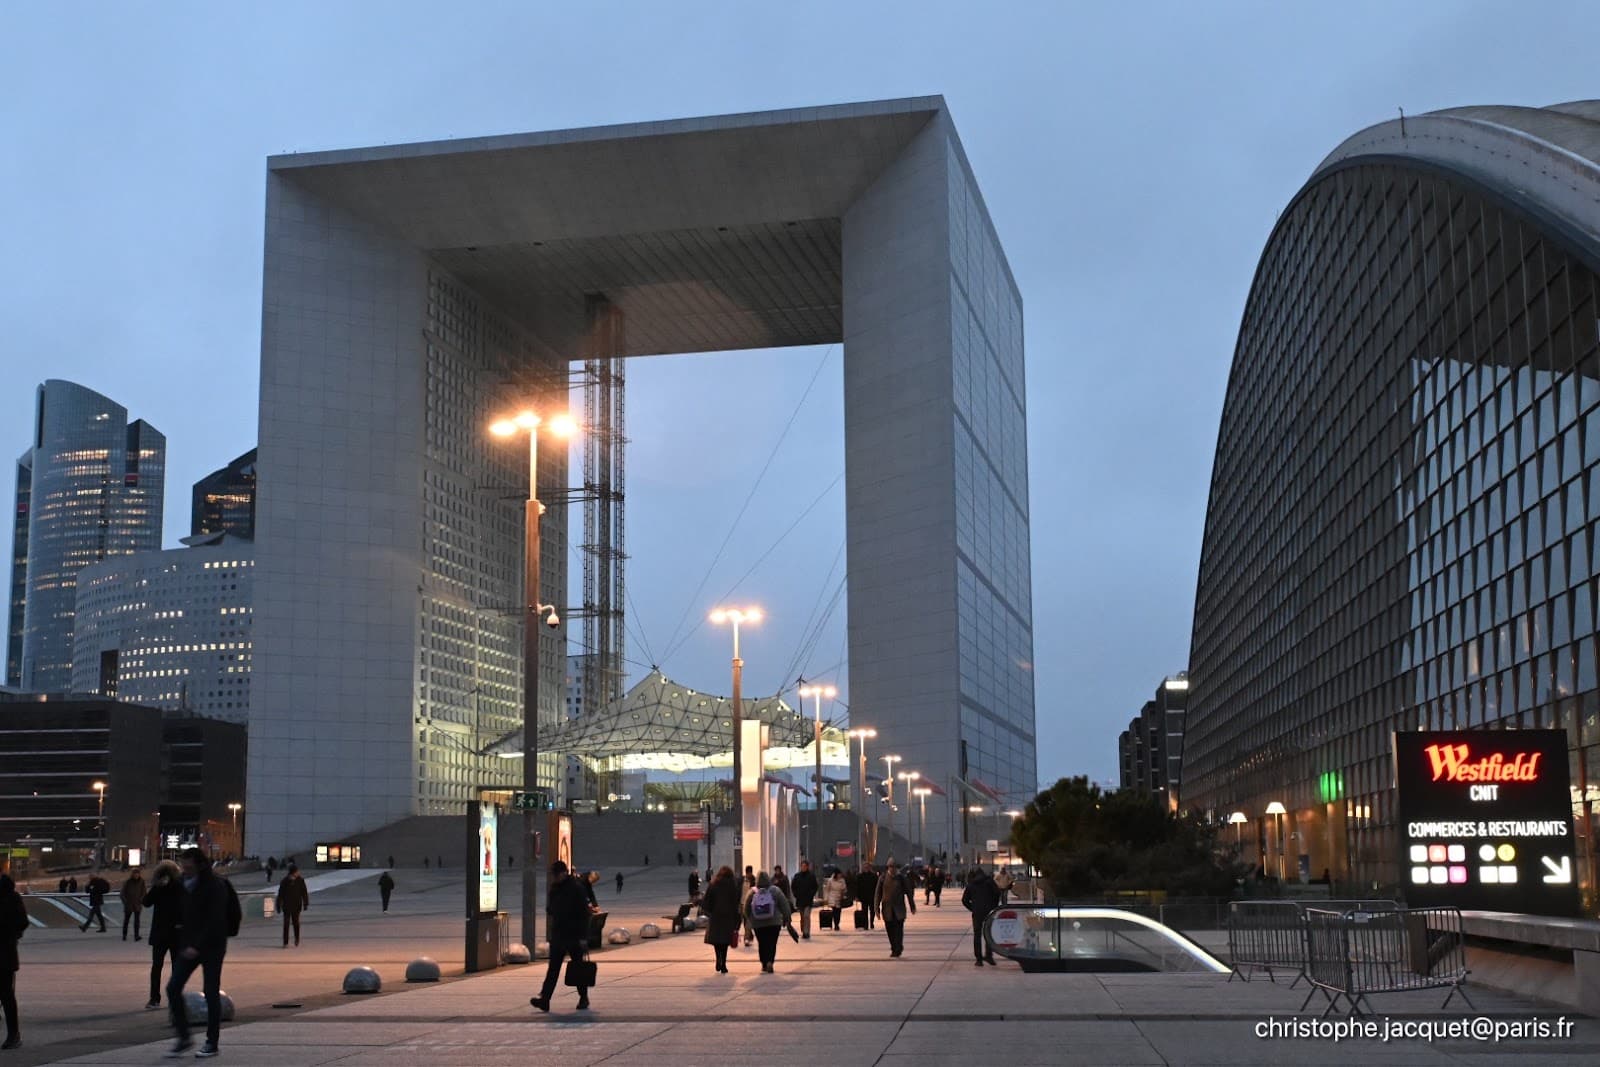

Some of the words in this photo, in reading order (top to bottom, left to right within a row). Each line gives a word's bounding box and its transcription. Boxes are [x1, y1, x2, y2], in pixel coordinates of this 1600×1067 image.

[1424, 744, 1541, 781] Westfield
[1469, 785, 1499, 801] CNIT
[1408, 822, 1477, 837] COMMERCES
[1478, 822, 1487, 837] &
[1488, 821, 1567, 837] RESTAURANTS
